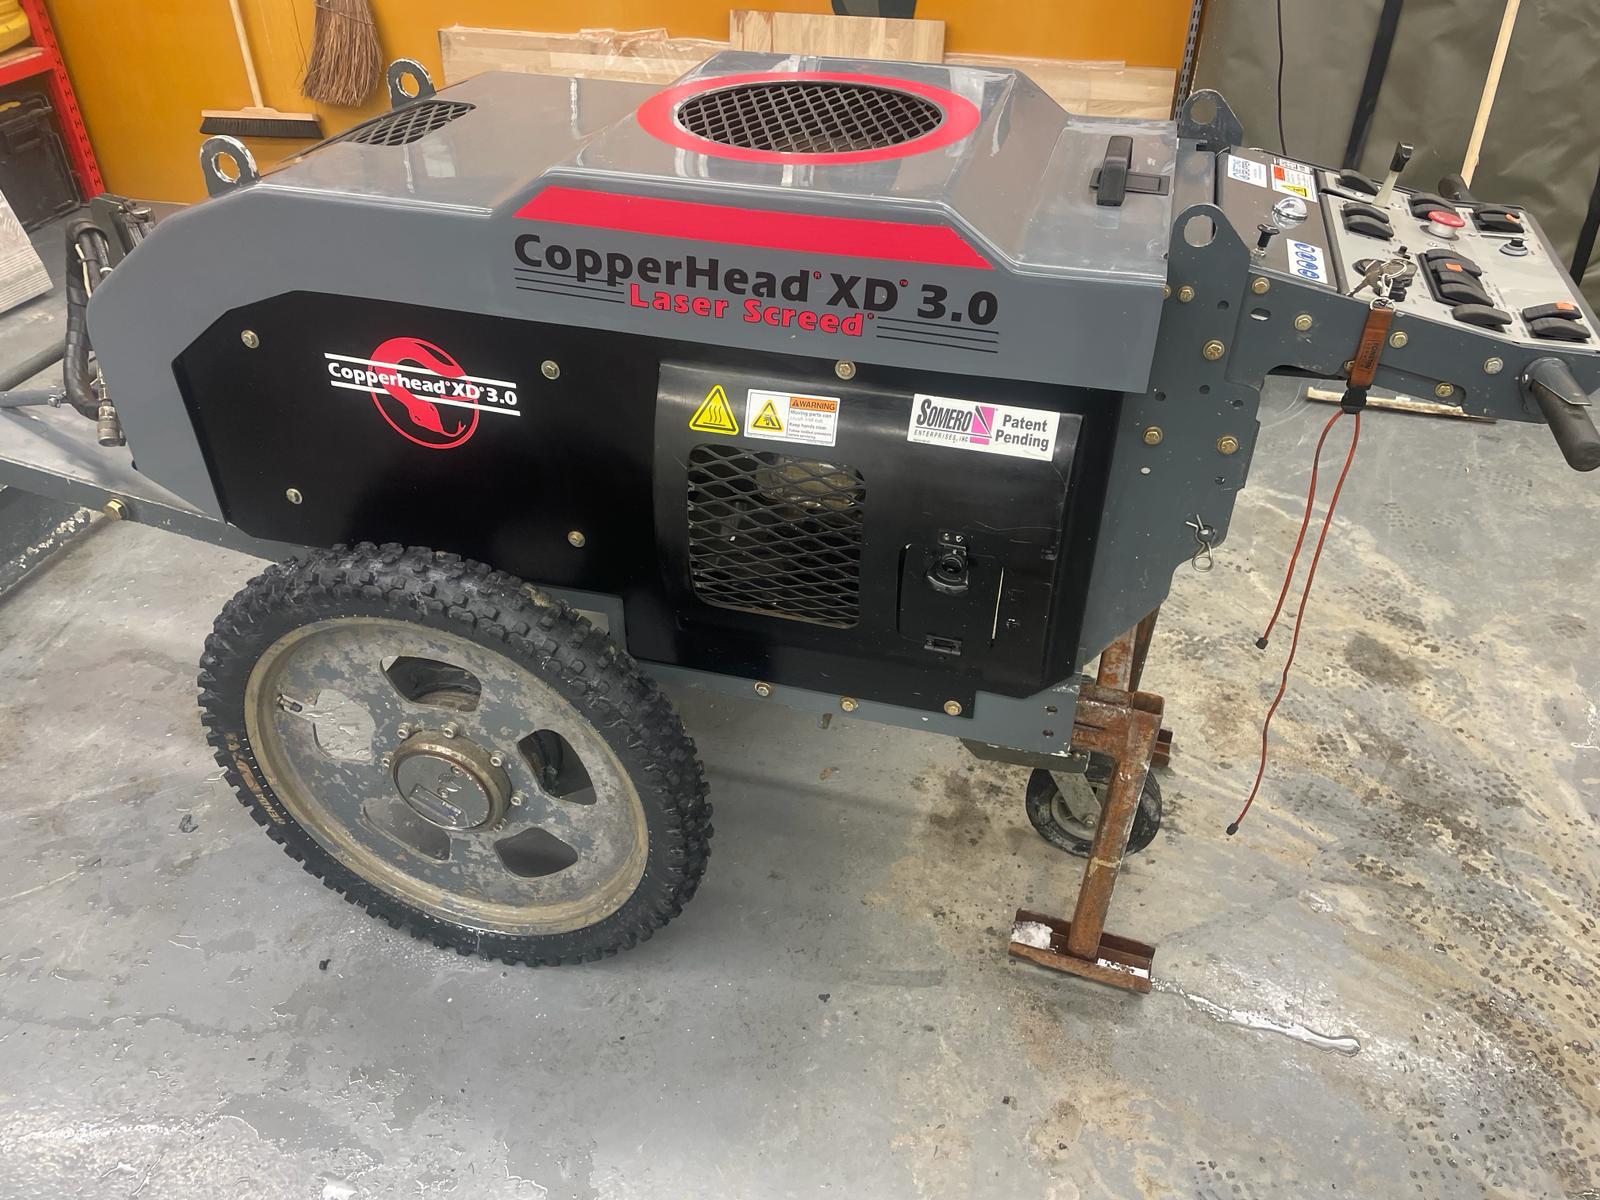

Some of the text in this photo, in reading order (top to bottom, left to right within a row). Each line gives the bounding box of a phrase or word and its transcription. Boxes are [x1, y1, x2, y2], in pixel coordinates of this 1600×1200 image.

[630, 283, 729, 318] Laser
[917, 284, 998, 325] 3.0
[485, 387, 518, 405] 3.0
[800, 400, 835, 410] WARNING
[1002, 414, 1048, 433] Patent
[995, 429, 1050, 451] Pending
